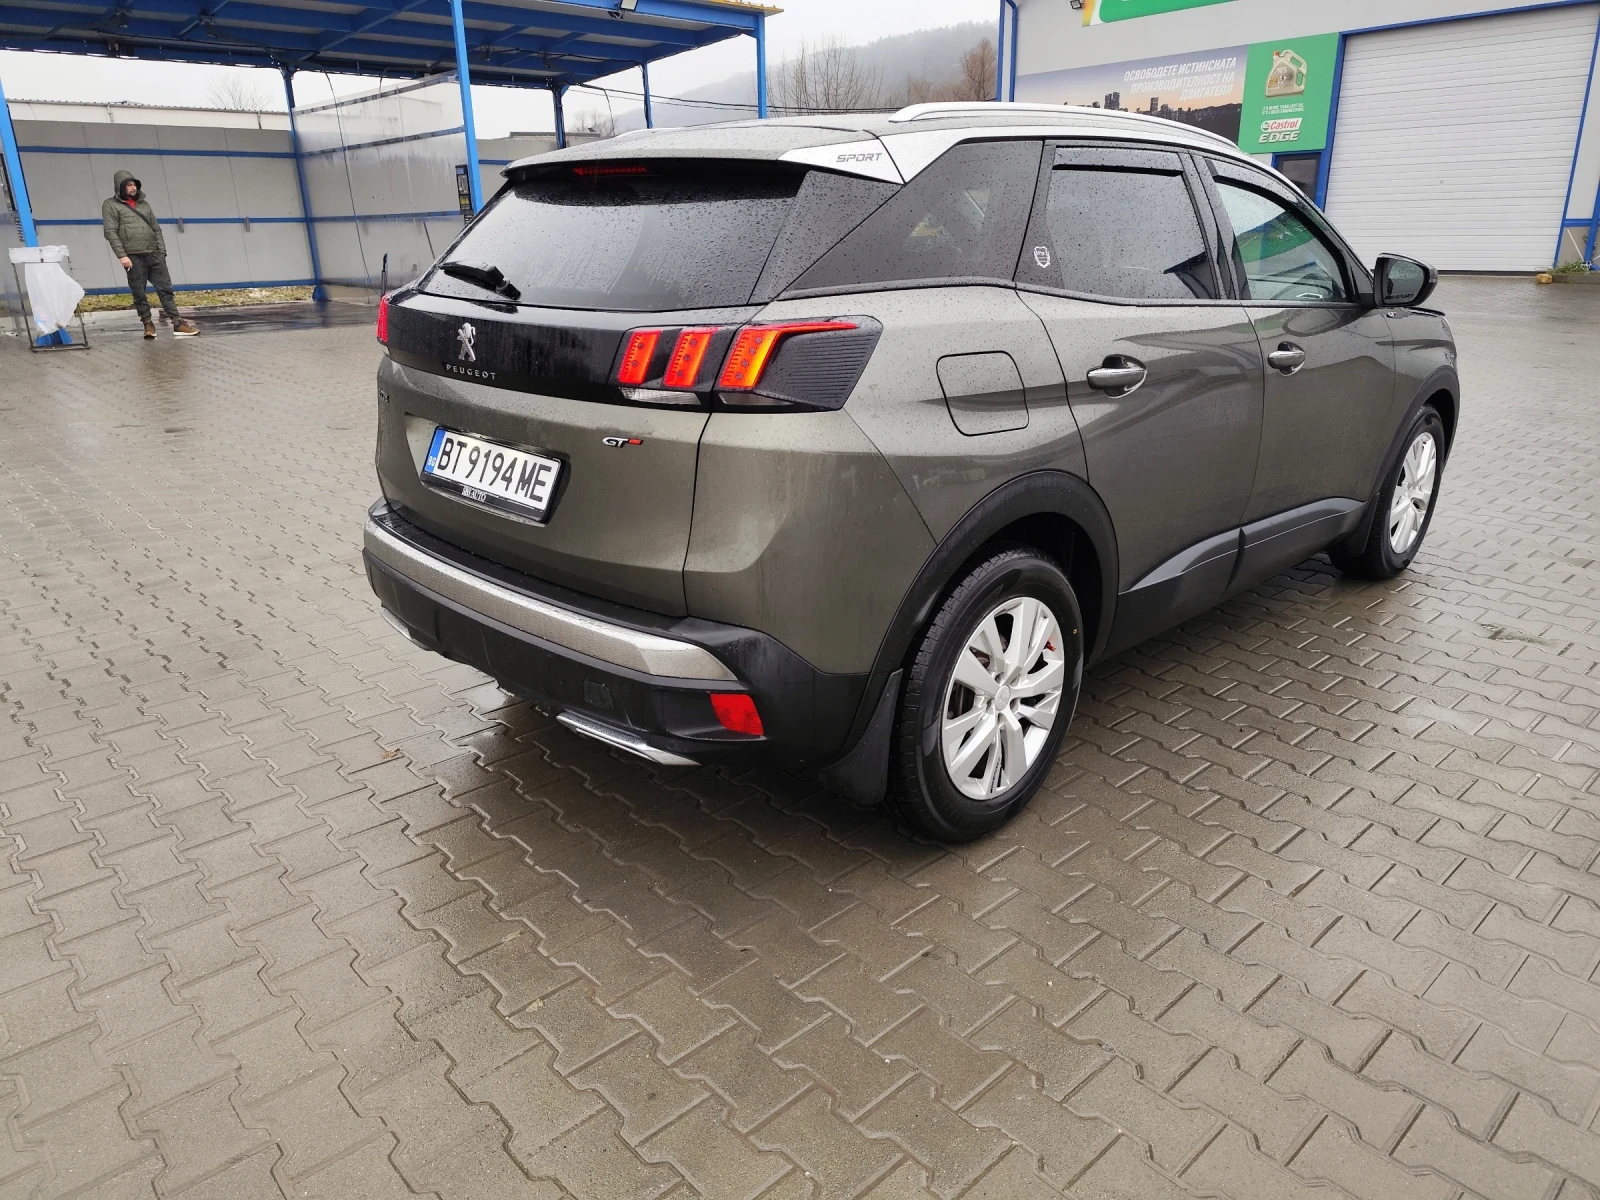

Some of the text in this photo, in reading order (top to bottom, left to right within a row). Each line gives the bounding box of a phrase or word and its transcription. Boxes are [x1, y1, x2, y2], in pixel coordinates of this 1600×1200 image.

[1124, 57, 1237, 81] ОСВОБОДЕТЕ ИСТИНСКАТА
[1130, 71, 1235, 93] ПРОИЗВОДИТЕЛНОСТ НА
[1180, 84, 1233, 101] ДВИГАТЕЛЯ
[1271, 120, 1299, 130] Castrol
[1258, 131, 1302, 143] EDGE
[836, 153, 882, 162] SPORT
[446, 364, 496, 380] PEUGEOT
[602, 437, 629, 447] GT
